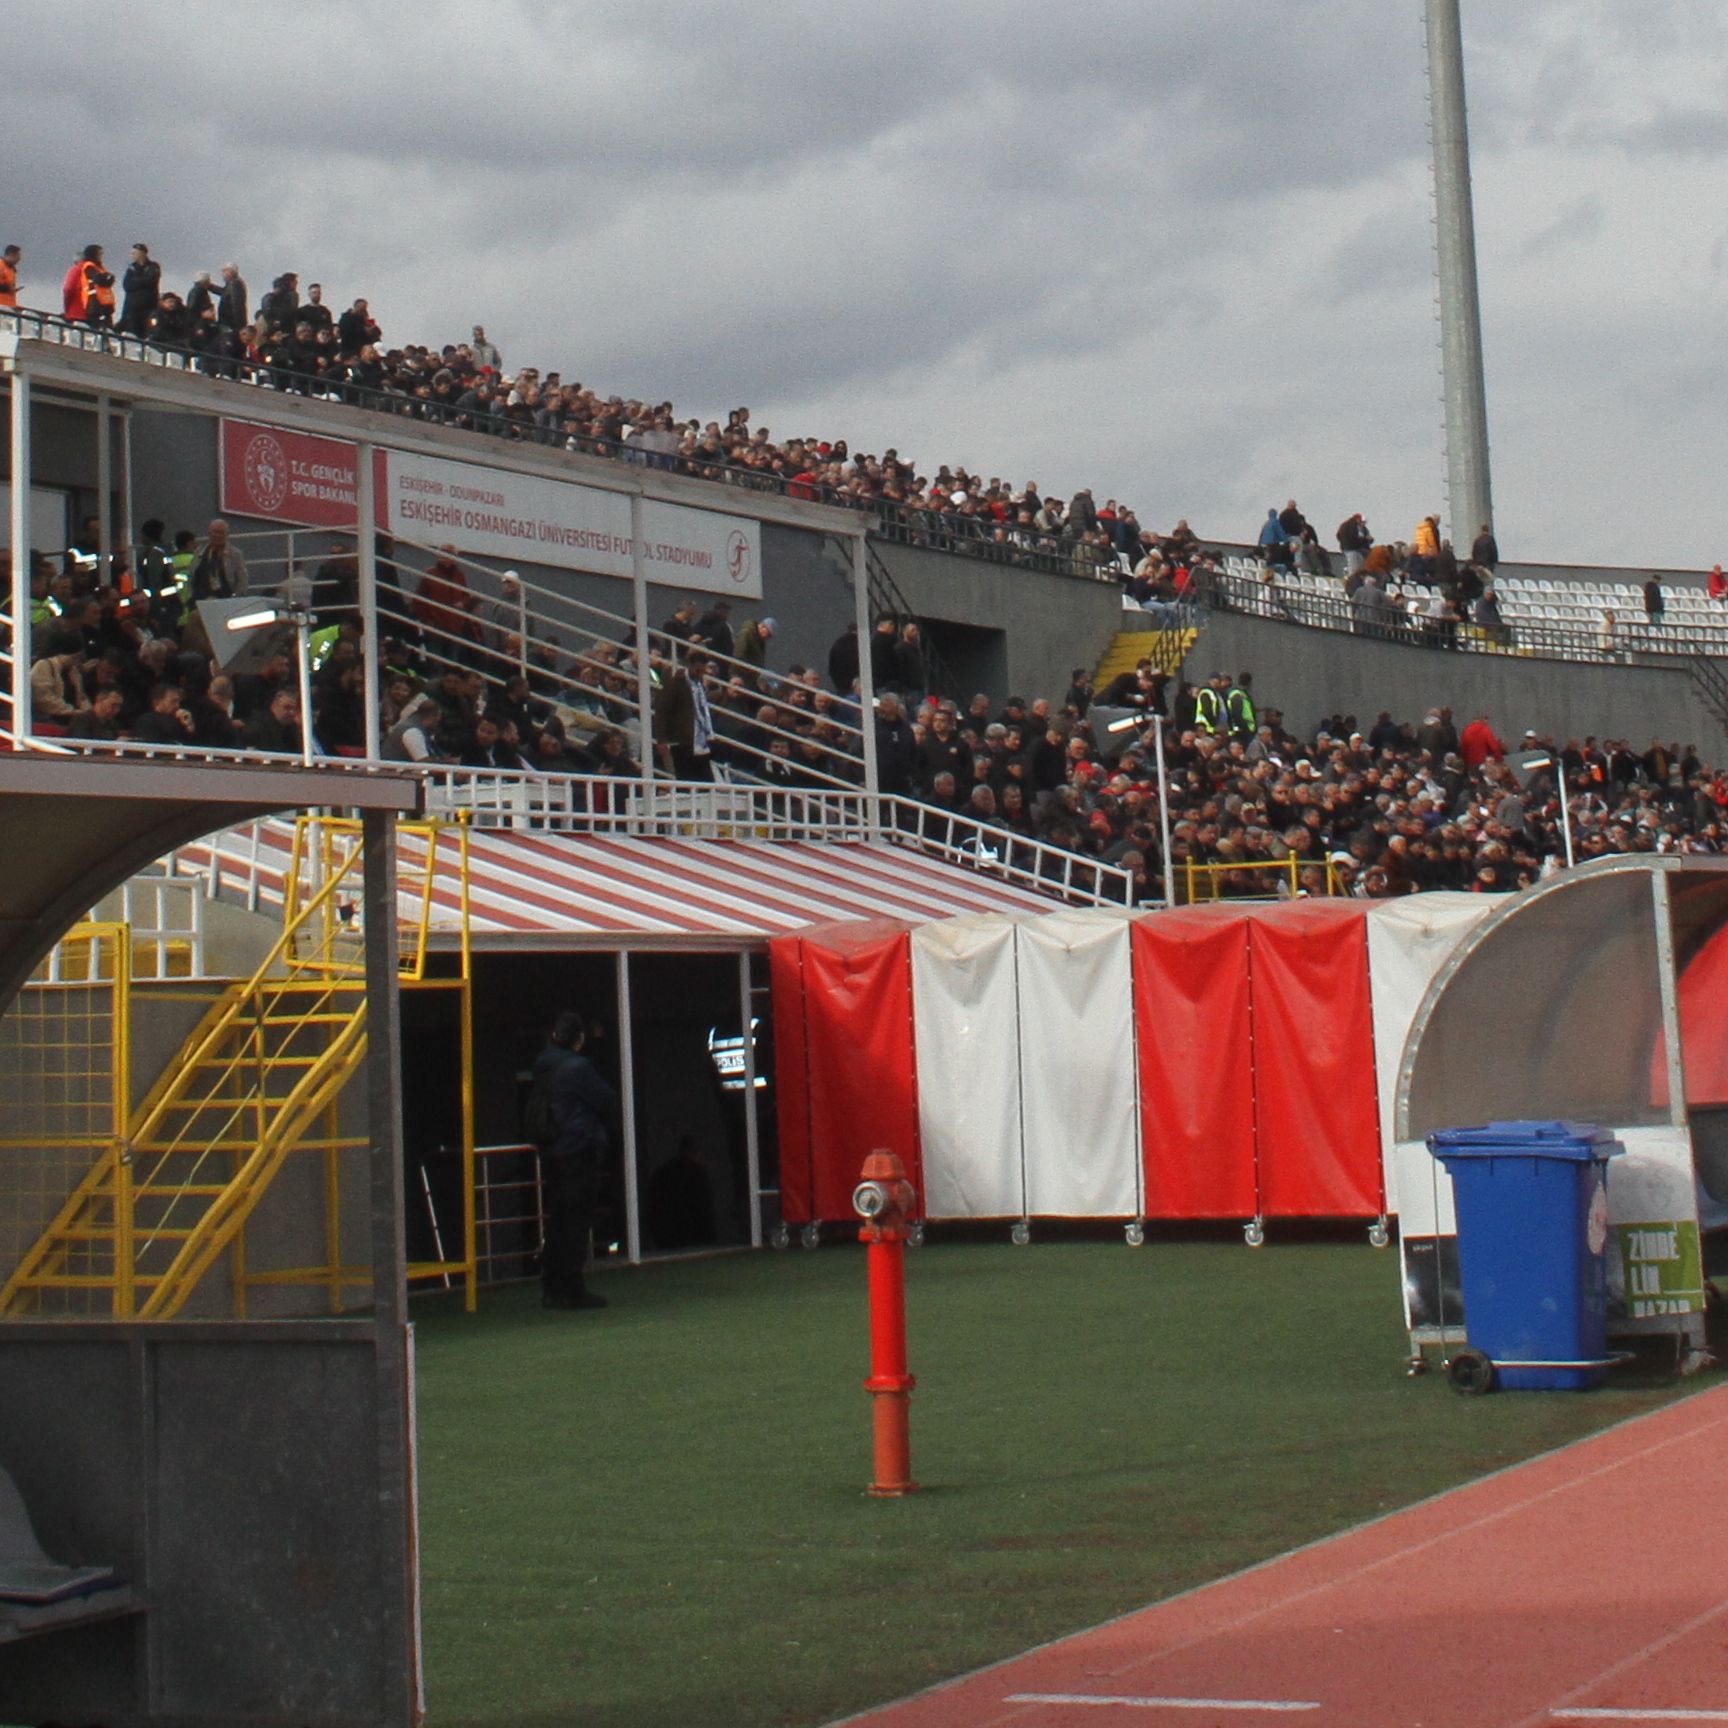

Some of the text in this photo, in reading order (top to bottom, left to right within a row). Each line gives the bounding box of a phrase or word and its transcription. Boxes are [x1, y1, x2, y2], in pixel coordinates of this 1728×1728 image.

[291, 460, 355, 485] T.C. GENÇLİK
[291, 481, 358, 506] SPOR BAKANL
[400, 499, 712, 569] ESKİŞEHİR OSMANGAZİ ÜNİVERSİTESİ FUTOL STADYUMU
[717, 1055, 744, 1069] POLİS
